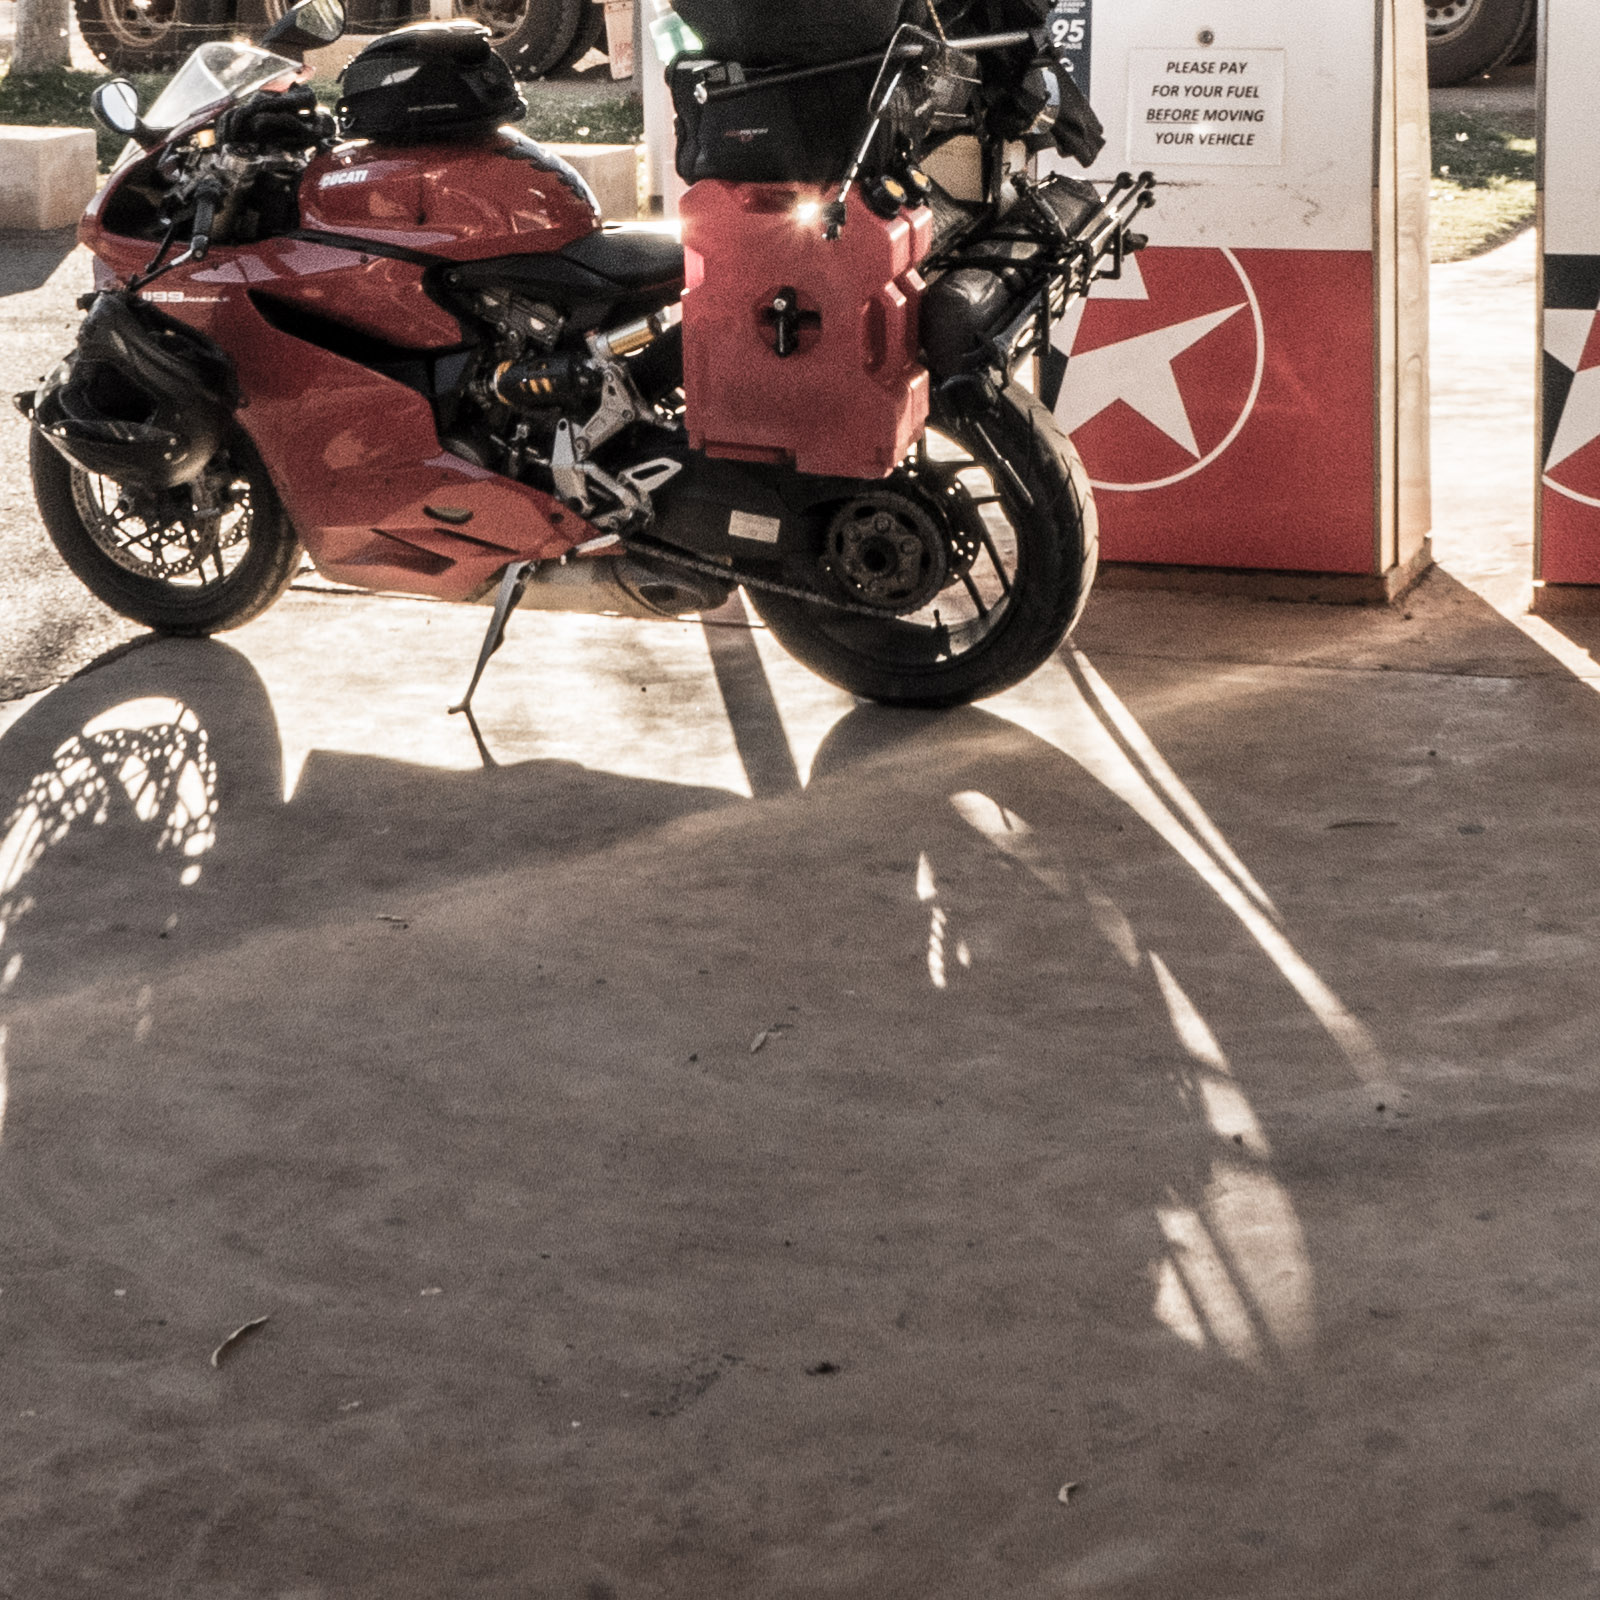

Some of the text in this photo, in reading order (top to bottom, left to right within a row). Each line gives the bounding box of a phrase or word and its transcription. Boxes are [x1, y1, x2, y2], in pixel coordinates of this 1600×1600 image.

[1051, 19, 1086, 44] 95
[1166, 62, 1248, 74] PLEASE PAY
[1151, 85, 1260, 98] FOR YOUR FUEL
[1146, 108, 1266, 122] BEFORE MOVING
[1155, 132, 1255, 146] YOUR VEHICLE
[319, 169, 369, 190] DUCATI
